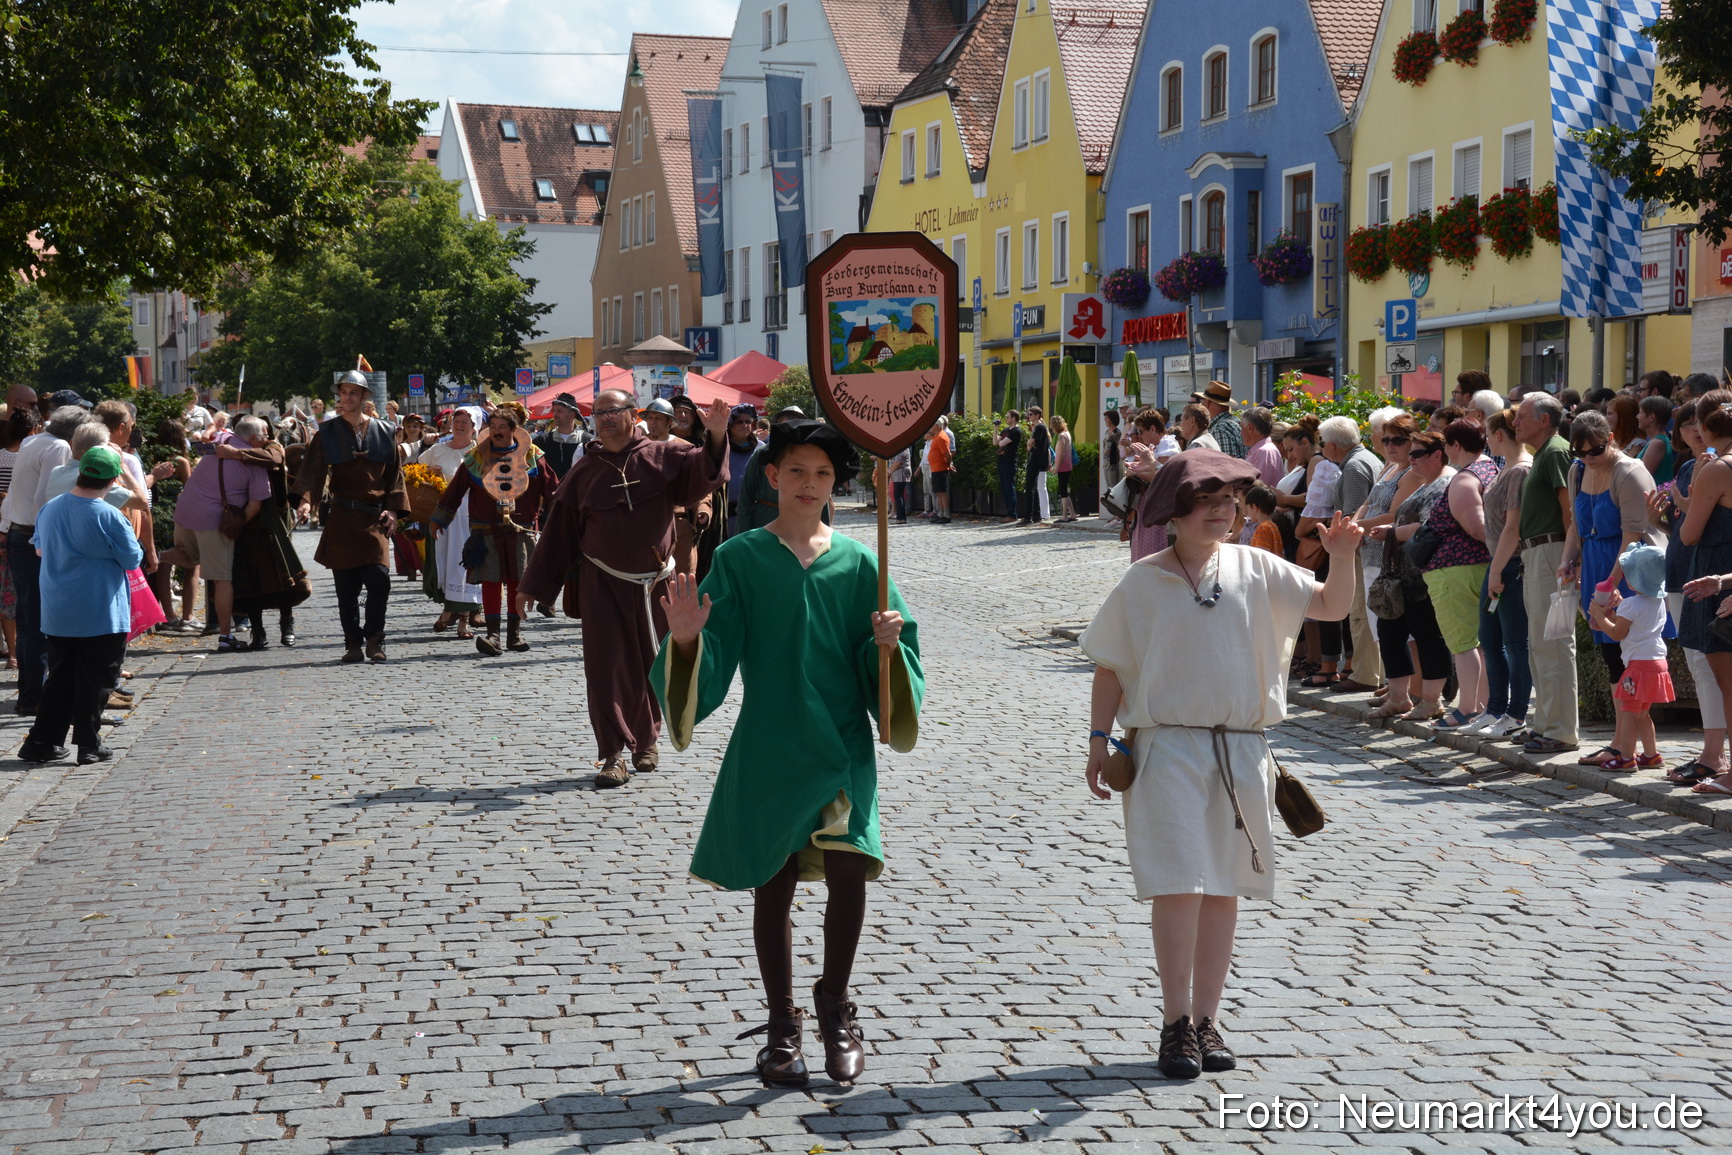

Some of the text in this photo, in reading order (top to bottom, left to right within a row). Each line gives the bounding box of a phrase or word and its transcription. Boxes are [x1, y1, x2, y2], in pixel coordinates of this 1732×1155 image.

[696, 166, 720, 225] K&L
[914, 203, 979, 234] HOTEL Lehmeier
[1318, 204, 1338, 222] CAFÉ
[1320, 225, 1336, 308] WITTL
[1675, 229, 1686, 307] KINO
[825, 286, 853, 298] Burg
[857, 280, 915, 297] Burgthann
[1392, 305, 1409, 337] P
